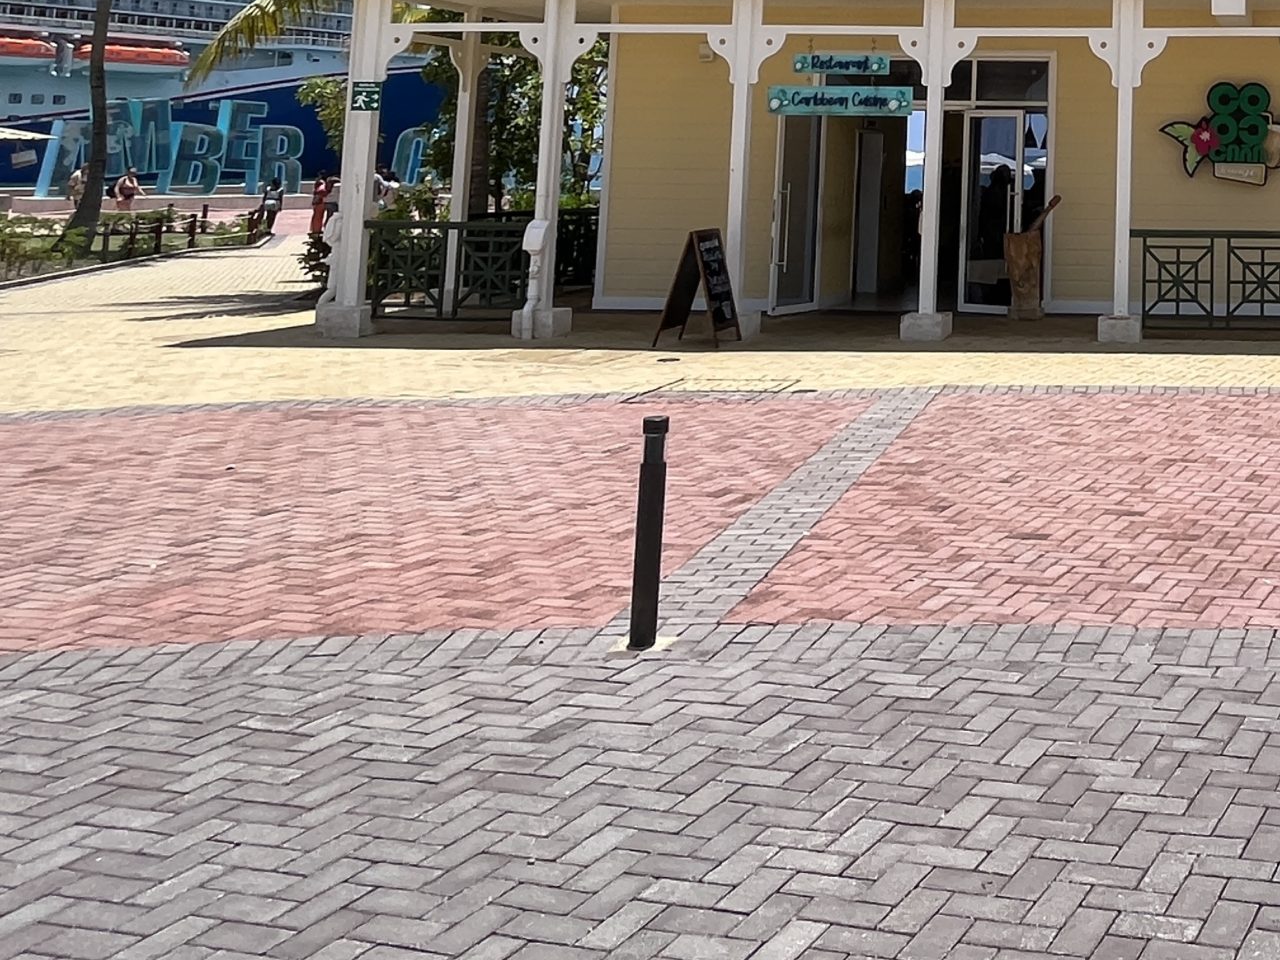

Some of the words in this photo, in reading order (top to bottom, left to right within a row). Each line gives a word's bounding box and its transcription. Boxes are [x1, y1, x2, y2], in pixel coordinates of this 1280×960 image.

[811, 55, 870, 72] Restaurant
[791, 91, 849, 110] Caribbean
[852, 91, 889, 109] Cuisine
